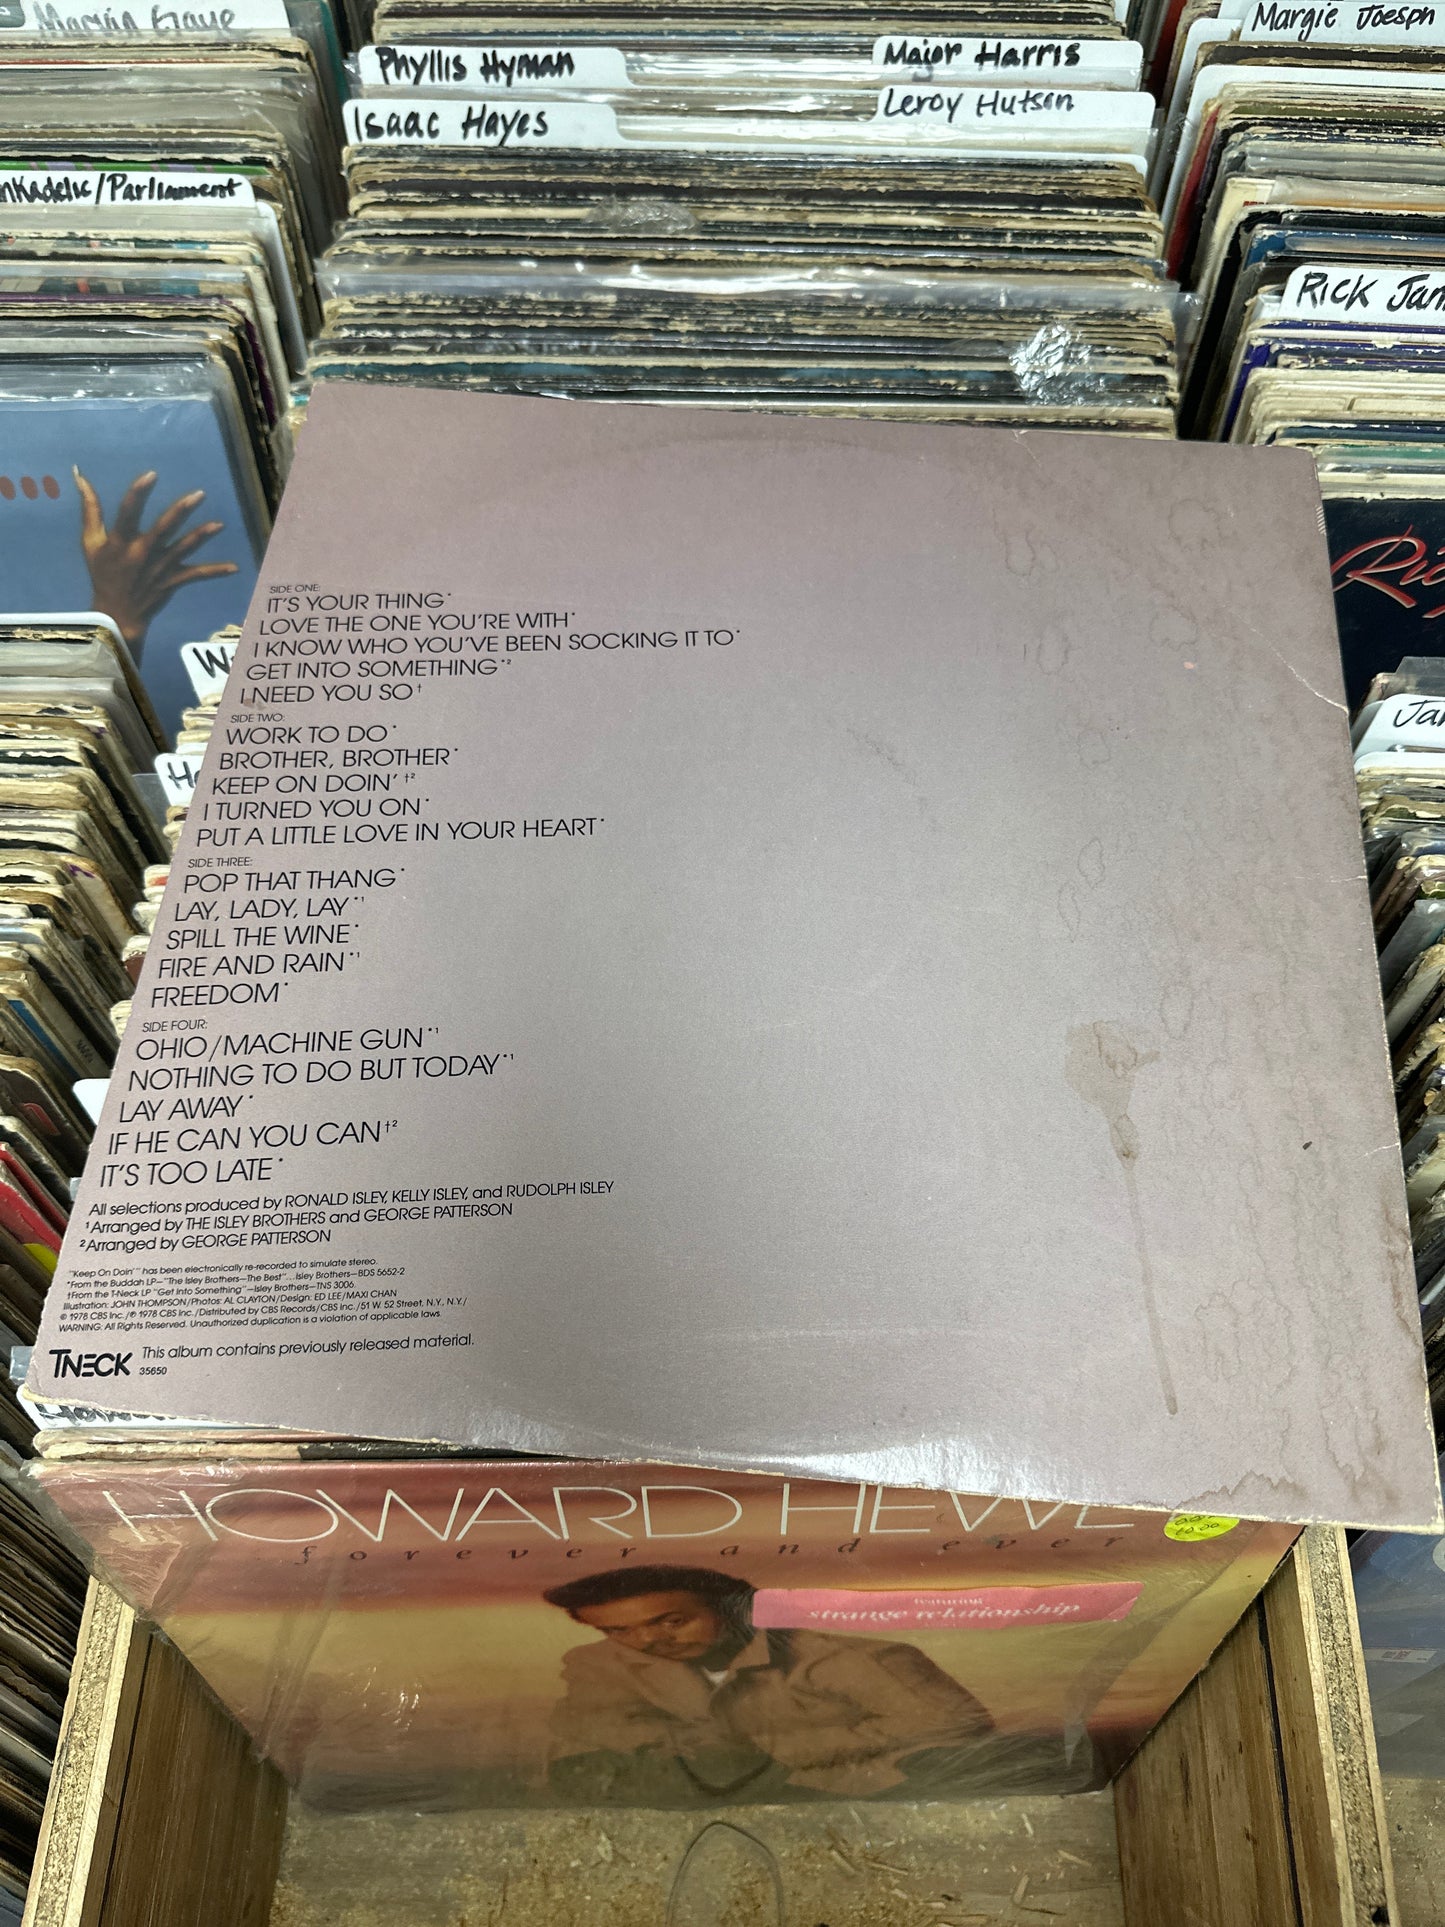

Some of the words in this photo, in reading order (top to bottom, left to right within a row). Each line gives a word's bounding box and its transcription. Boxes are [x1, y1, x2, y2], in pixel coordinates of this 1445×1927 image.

[1252, 2, 1338, 41] Margie
[378, 47, 467, 85] Phyllis
[480, 51, 574, 86] Hyman
[884, 40, 962, 81] Major
[974, 41, 1081, 69] Harris
[884, 90, 960, 122] Leroy
[976, 89, 1074, 117] Hutson
[353, 106, 440, 142] Isaac
[461, 105, 549, 146] Hayes
[1296, 271, 1378, 311] Rick
[270, 585, 292, 594] SIDE
[268, 598, 300, 613] IT'S
[307, 594, 369, 611] YOUR
[260, 618, 318, 635] LOVE
[325, 616, 363, 632] THE
[370, 615, 420, 632] ONE
[428, 613, 510, 630] YOU'RE
[254, 643, 258, 657] I
[266, 639, 342, 657] KNOW
[348, 637, 407, 654] WHO
[415, 636, 498, 653] YOU'VE
[506, 635, 560, 651] BEEN
[569, 632, 677, 650] SOCKING
[685, 631, 699, 647] IT
[246, 663, 291, 680] GET
[297, 662, 350, 679] INTO
[241, 688, 244, 704] I
[253, 685, 314, 704] NEED
[322, 684, 371, 702] YOU
[231, 715, 254, 723] SIDE
[226, 727, 302, 745] WORK
[309, 726, 339, 743] TO
[220, 751, 334, 770] BROTHER,
[212, 777, 269, 795] KEEP
[276, 775, 316, 793] ON
[204, 804, 208, 820] I
[216, 801, 311, 820] TURNED
[319, 800, 371, 818] YOU
[197, 828, 240, 847] PUT
[245, 828, 264, 846] A
[272, 826, 336, 844] LITTLE
[344, 824, 407, 843] LOVE
[416, 823, 439, 841] IN
[447, 821, 515, 839] YOUR
[188, 858, 213, 868] SIDE
[184, 874, 238, 893] POP
[245, 871, 301, 891] THAT
[174, 901, 219, 921] LAY,
[230, 899, 297, 919] LADY,
[166, 929, 225, 950] SPILL
[234, 927, 276, 947] THE
[159, 957, 207, 979] FIRE
[213, 955, 274, 976] AND
[142, 1022, 168, 1033] SIDE
[171, 1019, 207, 1031] FOUR:
[129, 1065, 254, 1091] NOTHING
[262, 1063, 297, 1084] TO
[306, 1060, 351, 1082] DO
[361, 1058, 406, 1080] BUT
[120, 1099, 164, 1122] LAY
[108, 1133, 129, 1154] IF
[135, 1130, 169, 1153] HE
[177, 1127, 240, 1152] CAN
[250, 1124, 307, 1147] YOU
[100, 1164, 140, 1187] IT'S
[148, 1161, 207, 1185] TOO
[89, 1203, 106, 1216] All
[110, 1202, 182, 1215] selections
[185, 1197, 259, 1214] produced
[264, 1197, 282, 1211] by
[285, 1193, 348, 1207] RONALD
[352, 1191, 388, 1205] ISLEY,
[392, 1189, 430, 1202] KELLY
[433, 1187, 468, 1201] ISLEY,
[473, 1186, 502, 1198] and
[507, 1183, 576, 1197] RUDOLPH
[580, 1181, 614, 1194] ISLEY
[165, 1219, 183, 1233] by
[186, 1217, 210, 1230] THE
[214, 1216, 250, 1229] ISLEY
[252, 1212, 326, 1228] BROTHERS
[329, 1210, 360, 1223] and
[364, 1207, 429, 1222] GEORGE
[434, 1203, 513, 1219] PATTERSON
[160, 1236, 179, 1251] by
[182, 1233, 247, 1248] GEORGE
[251, 1230, 331, 1245] PATTERSON
[160, 1266, 182, 1274] been
[185, 1264, 242, 1274] electronically
[245, 1262, 296, 1271] re-recorded
[310, 1259, 346, 1267] simulate
[60, 1323, 102, 1332] WARNING:
[104, 1322, 115, 1331] All
[117, 1322, 143, 1331] Rights
[190, 1318, 248, 1328] Unauthorized
[251, 1316, 300, 1326] duplication
[320, 1313, 357, 1322] violation
[360, 1312, 368, 1320] of
[370, 1311, 418, 1321] applicable
[142, 1346, 165, 1359] This
[168, 1346, 212, 1358] album
[216, 1343, 275, 1356] contains
[279, 1340, 347, 1356] previously
[350, 1337, 409, 1351] released
[413, 1333, 474, 1348] material.
[139, 1367, 167, 1376] 35650
[102, 1485, 743, 1543] HOWARD
[296, 1545, 636, 1564] forever
[720, 1537, 862, 1557] and
[942, 1535, 1124, 1553] ever
[806, 1608, 908, 1622] strange
[916, 1603, 1081, 1620] relationship
